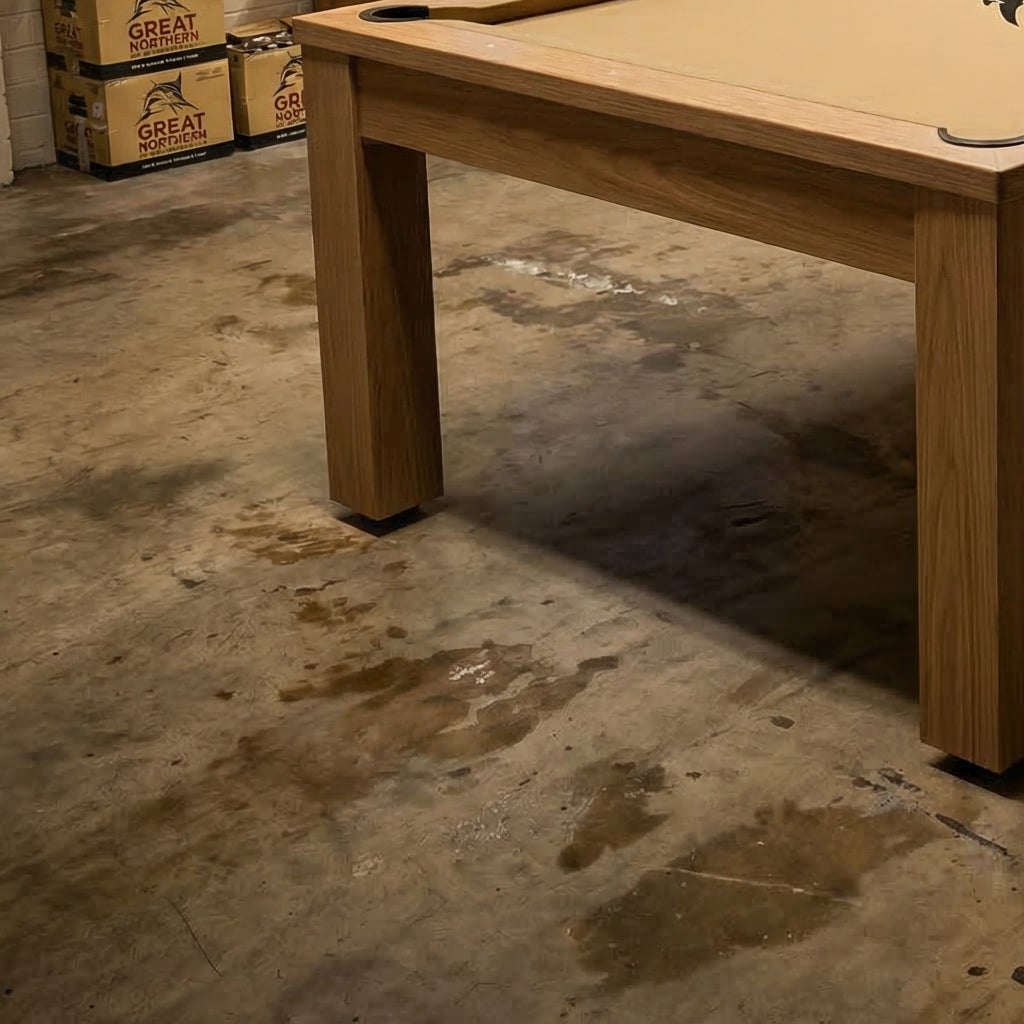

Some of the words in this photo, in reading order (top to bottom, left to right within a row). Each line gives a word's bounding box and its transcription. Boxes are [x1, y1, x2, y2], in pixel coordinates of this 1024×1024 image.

[129, 13, 197, 40] GREAT
[130, 30, 199, 53] NORTHERN
[138, 112, 206, 141] GREAT
